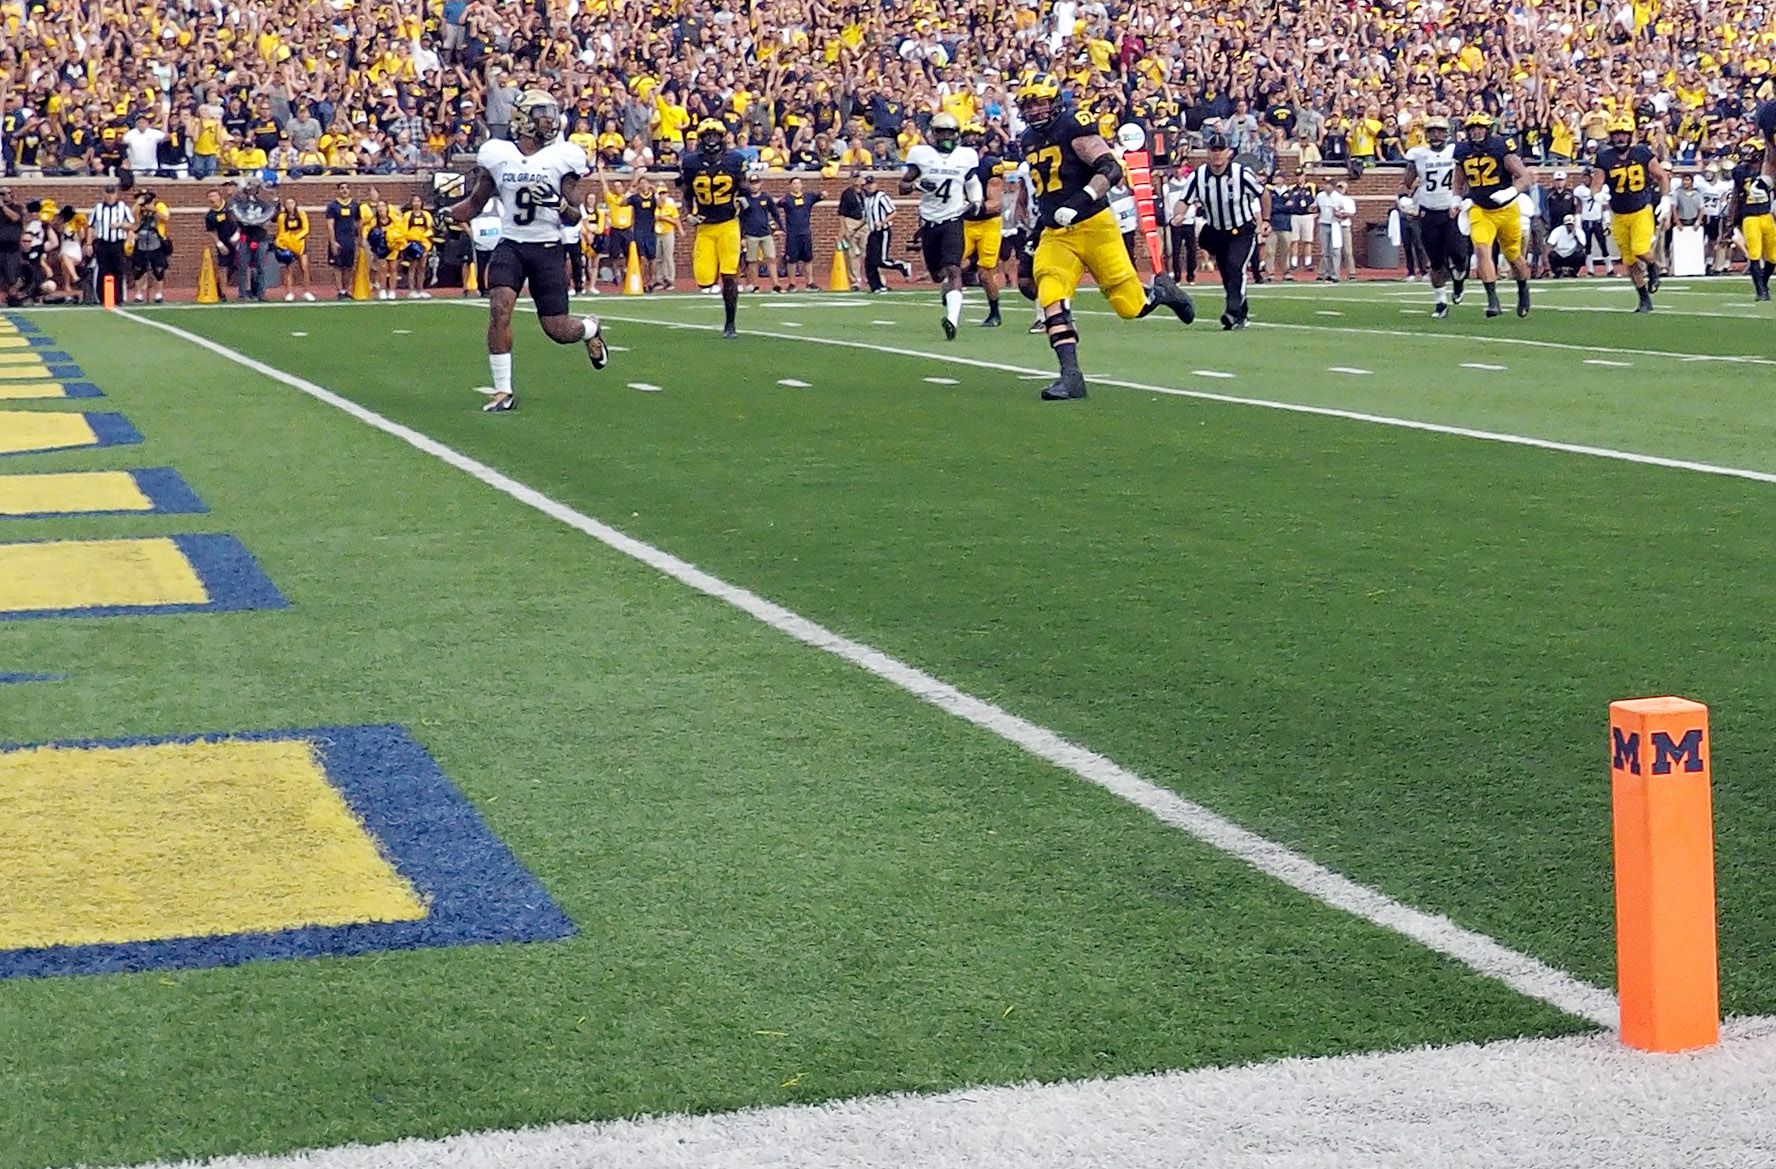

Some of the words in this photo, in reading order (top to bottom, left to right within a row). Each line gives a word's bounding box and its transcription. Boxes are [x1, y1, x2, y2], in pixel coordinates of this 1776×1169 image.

[502, 172, 549, 183] COLORADO
[1025, 144, 1063, 198] 67
[1425, 169, 1454, 192] 54
[1463, 156, 1500, 187] 52
[1608, 164, 1646, 194] 78
[692, 174, 734, 206] 82
[935, 178, 953, 204] 4
[513, 187, 537, 226] 9
[1613, 727, 1641, 777] M
[1651, 729, 1704, 776] M
